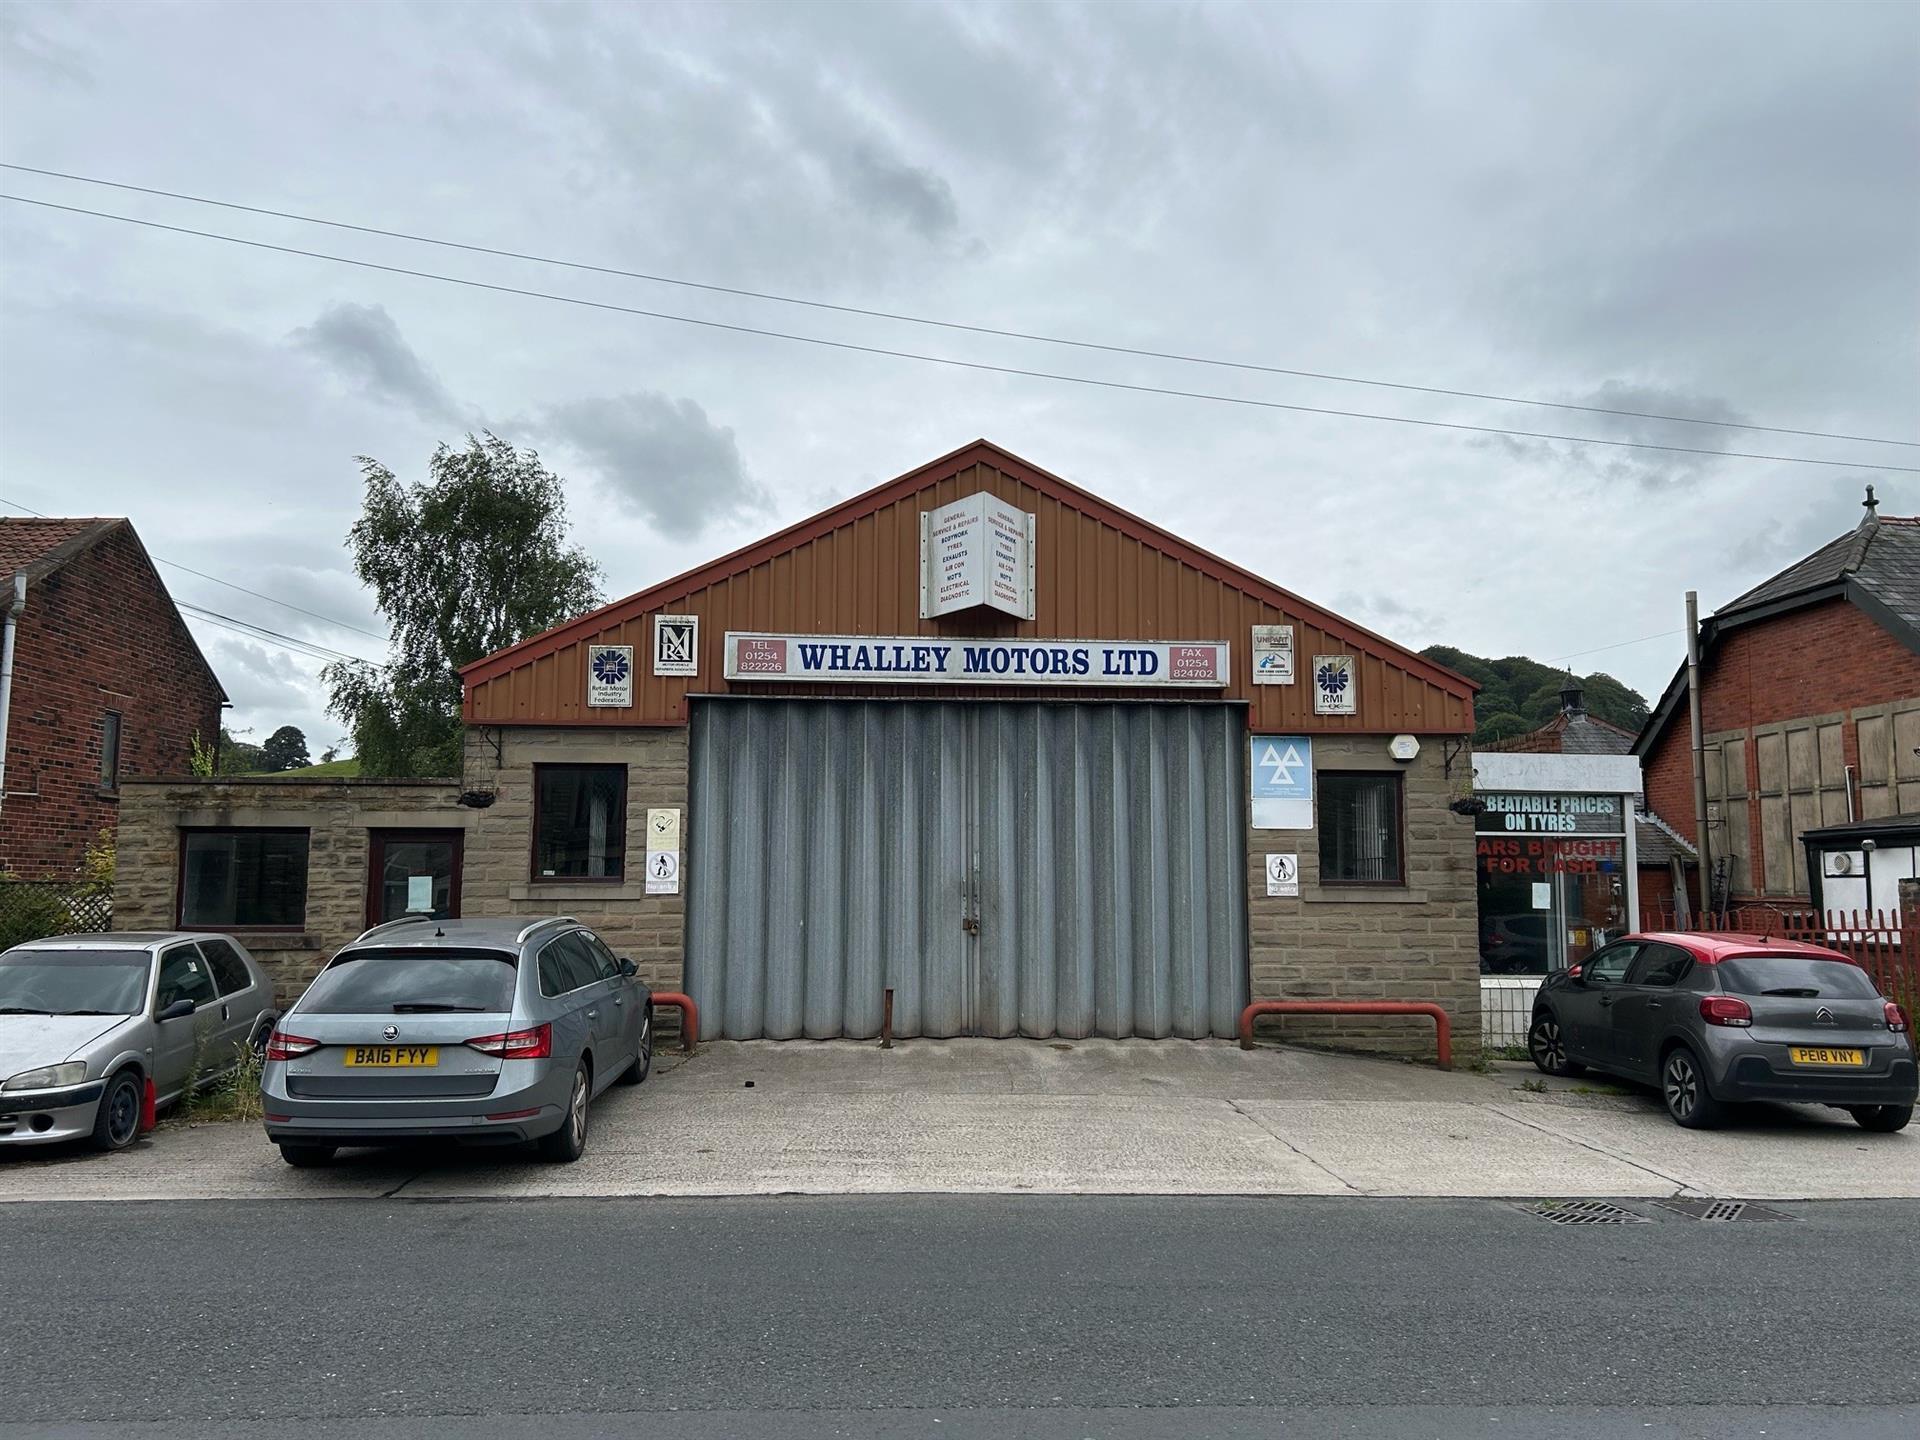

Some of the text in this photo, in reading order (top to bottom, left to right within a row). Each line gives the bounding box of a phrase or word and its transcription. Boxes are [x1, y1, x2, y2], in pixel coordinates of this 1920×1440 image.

[944, 511, 965, 523] GENERAL
[932, 525, 951, 537] SERVICE
[958, 515, 978, 528] REPAIRS
[941, 530, 968, 544] BODYWORK
[994, 530, 1016, 544] BODYWORK
[947, 541, 962, 551] TYRES
[1000, 542, 1012, 552] TYRES
[942, 550, 968, 563] EXHAUSTS
[995, 550, 1016, 564] EXHAUSTS
[945, 561, 965, 572] AIR CON
[940, 580, 970, 593] ELECTRICAL
[994, 580, 1017, 594] ELECTRICAL
[940, 589, 970, 602] DIAGNOSTIC
[751, 641, 774, 650] TEL.
[1256, 635, 1288, 643] UNIPART
[745, 651, 778, 661] 01254
[1181, 648, 1205, 657] FAX.
[798, 644, 1159, 675] WHALLEY MOTORS LTD
[1177, 659, 1209, 667] 01254
[740, 662, 782, 671] 822226
[1173, 669, 1213, 678] 824702
[1322, 694, 1343, 703] RMI
[1476, 795, 1614, 813] BEATABLE PRICES
[1505, 813, 1576, 831] ON TYRES
[1477, 840, 1618, 856] ARS BOUGHT
[1486, 857, 1597, 873] FOR CASH
[354, 1048, 429, 1064] BA16 FYY
[1799, 1049, 1854, 1062] PE18 VNY
